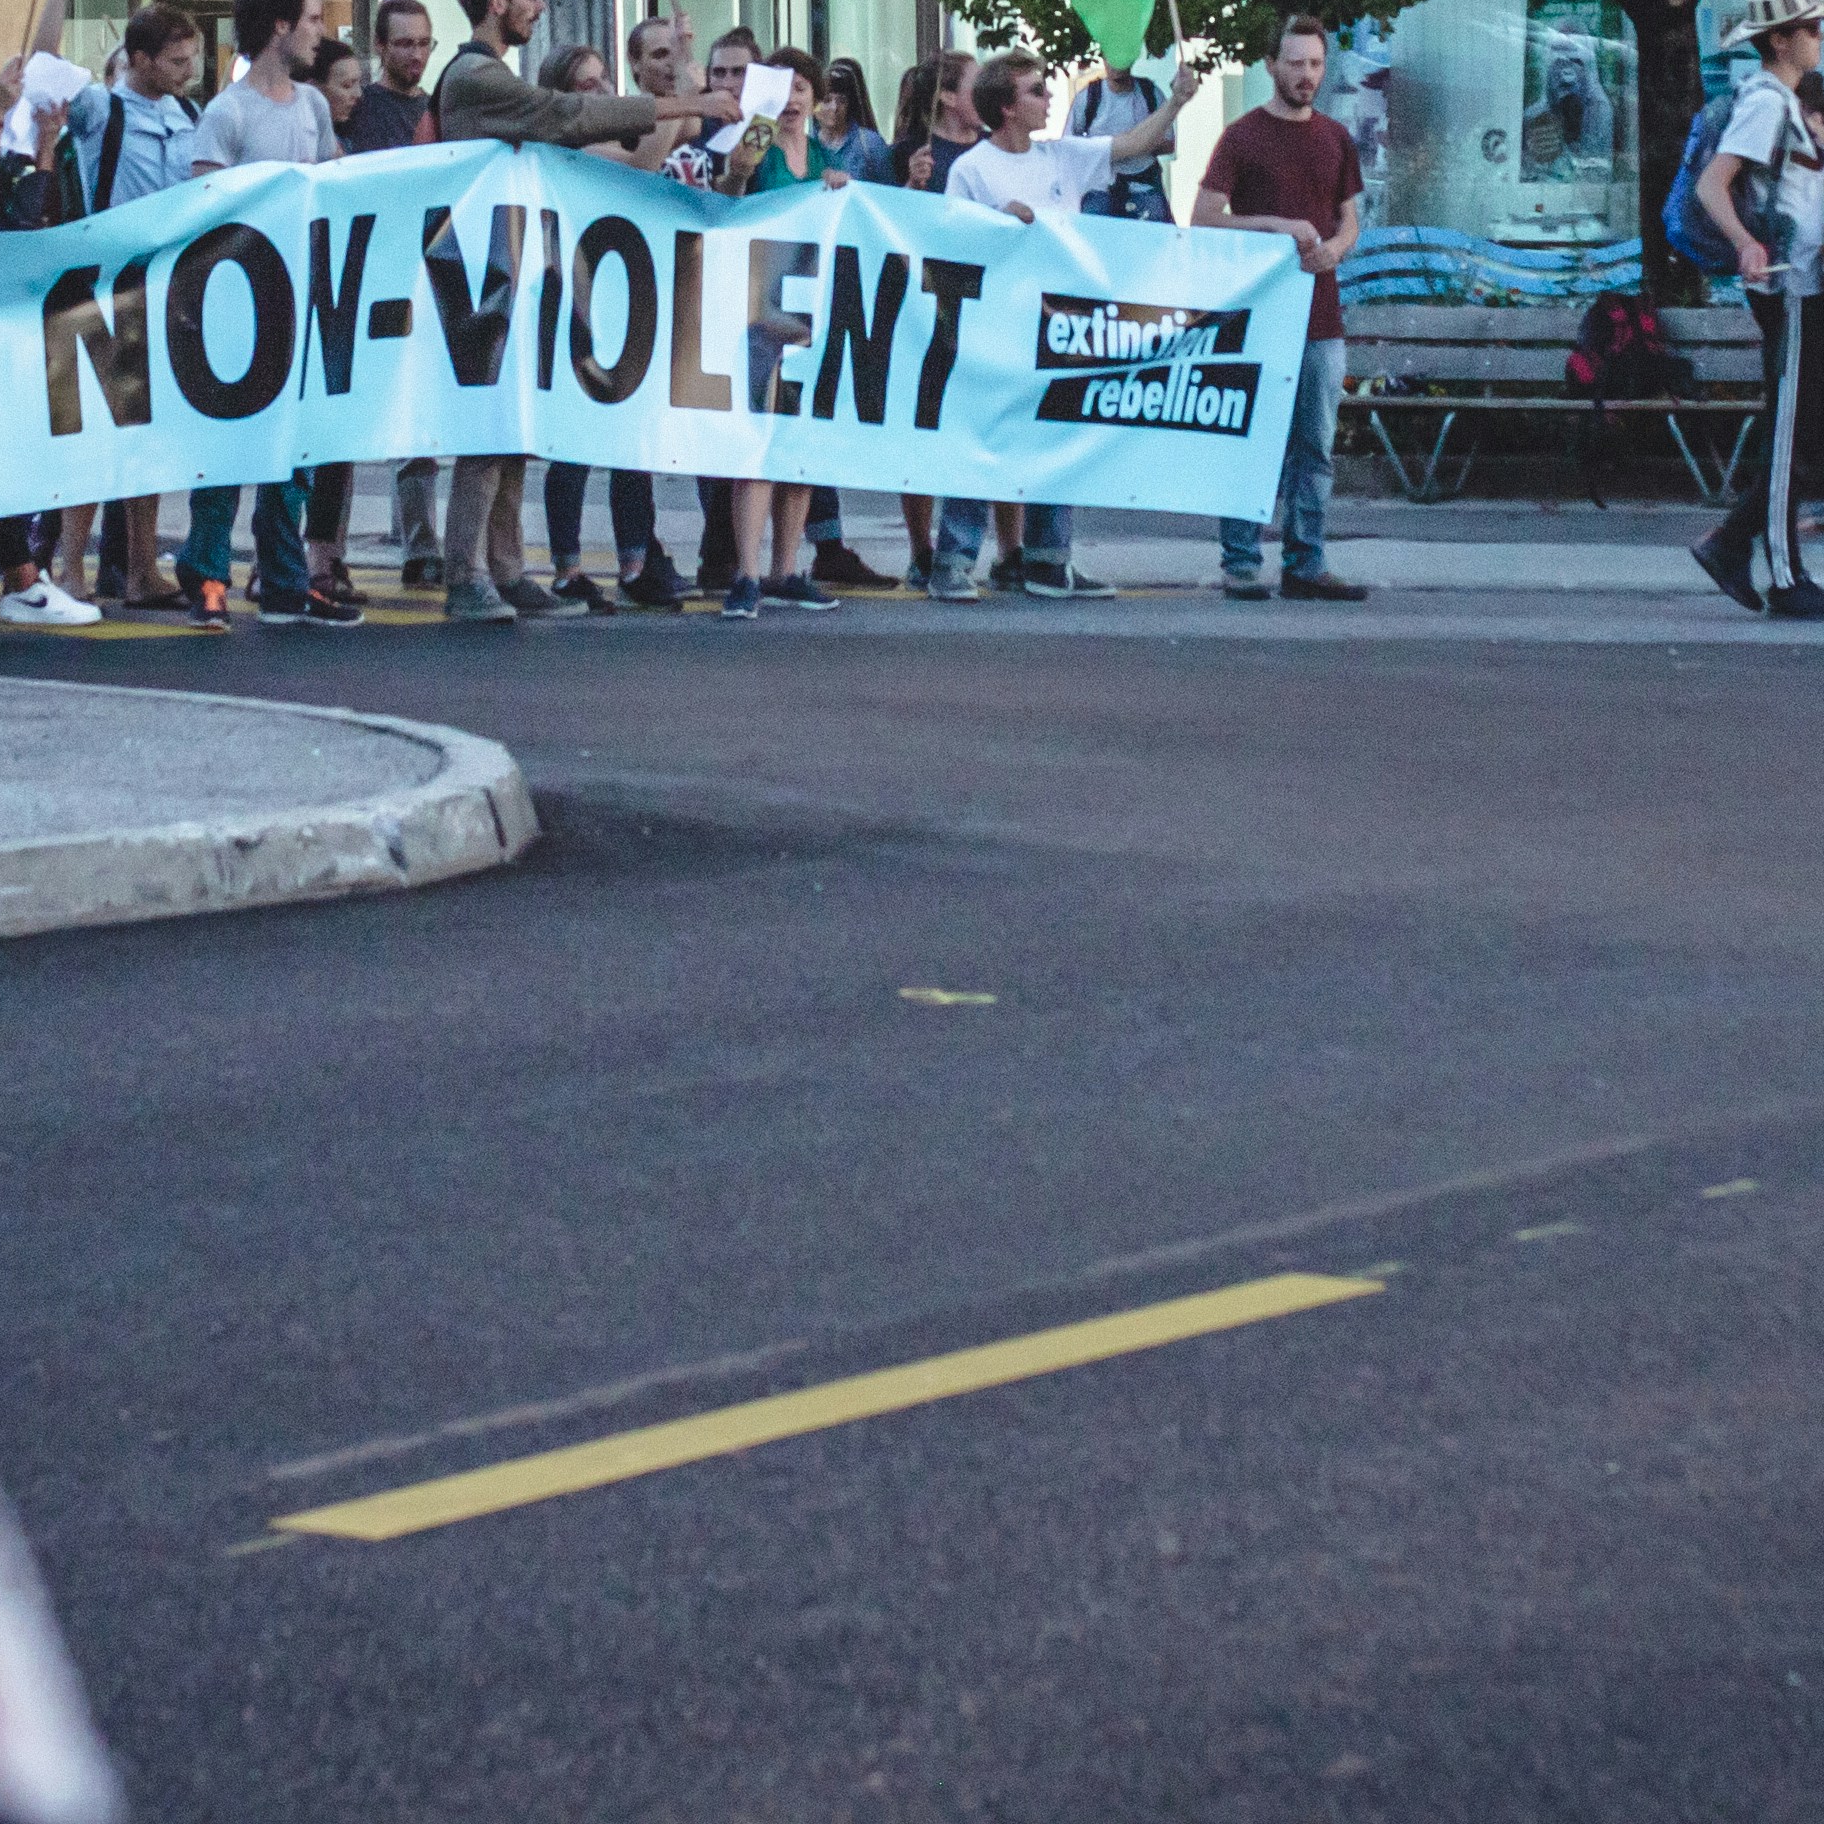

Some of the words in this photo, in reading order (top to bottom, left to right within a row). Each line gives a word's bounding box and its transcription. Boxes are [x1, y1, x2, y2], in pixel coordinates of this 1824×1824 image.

[43, 204, 986, 436] NON-VIOLENT
[1047, 303, 1220, 360] extinction
[1082, 362, 1248, 429] rebellion
